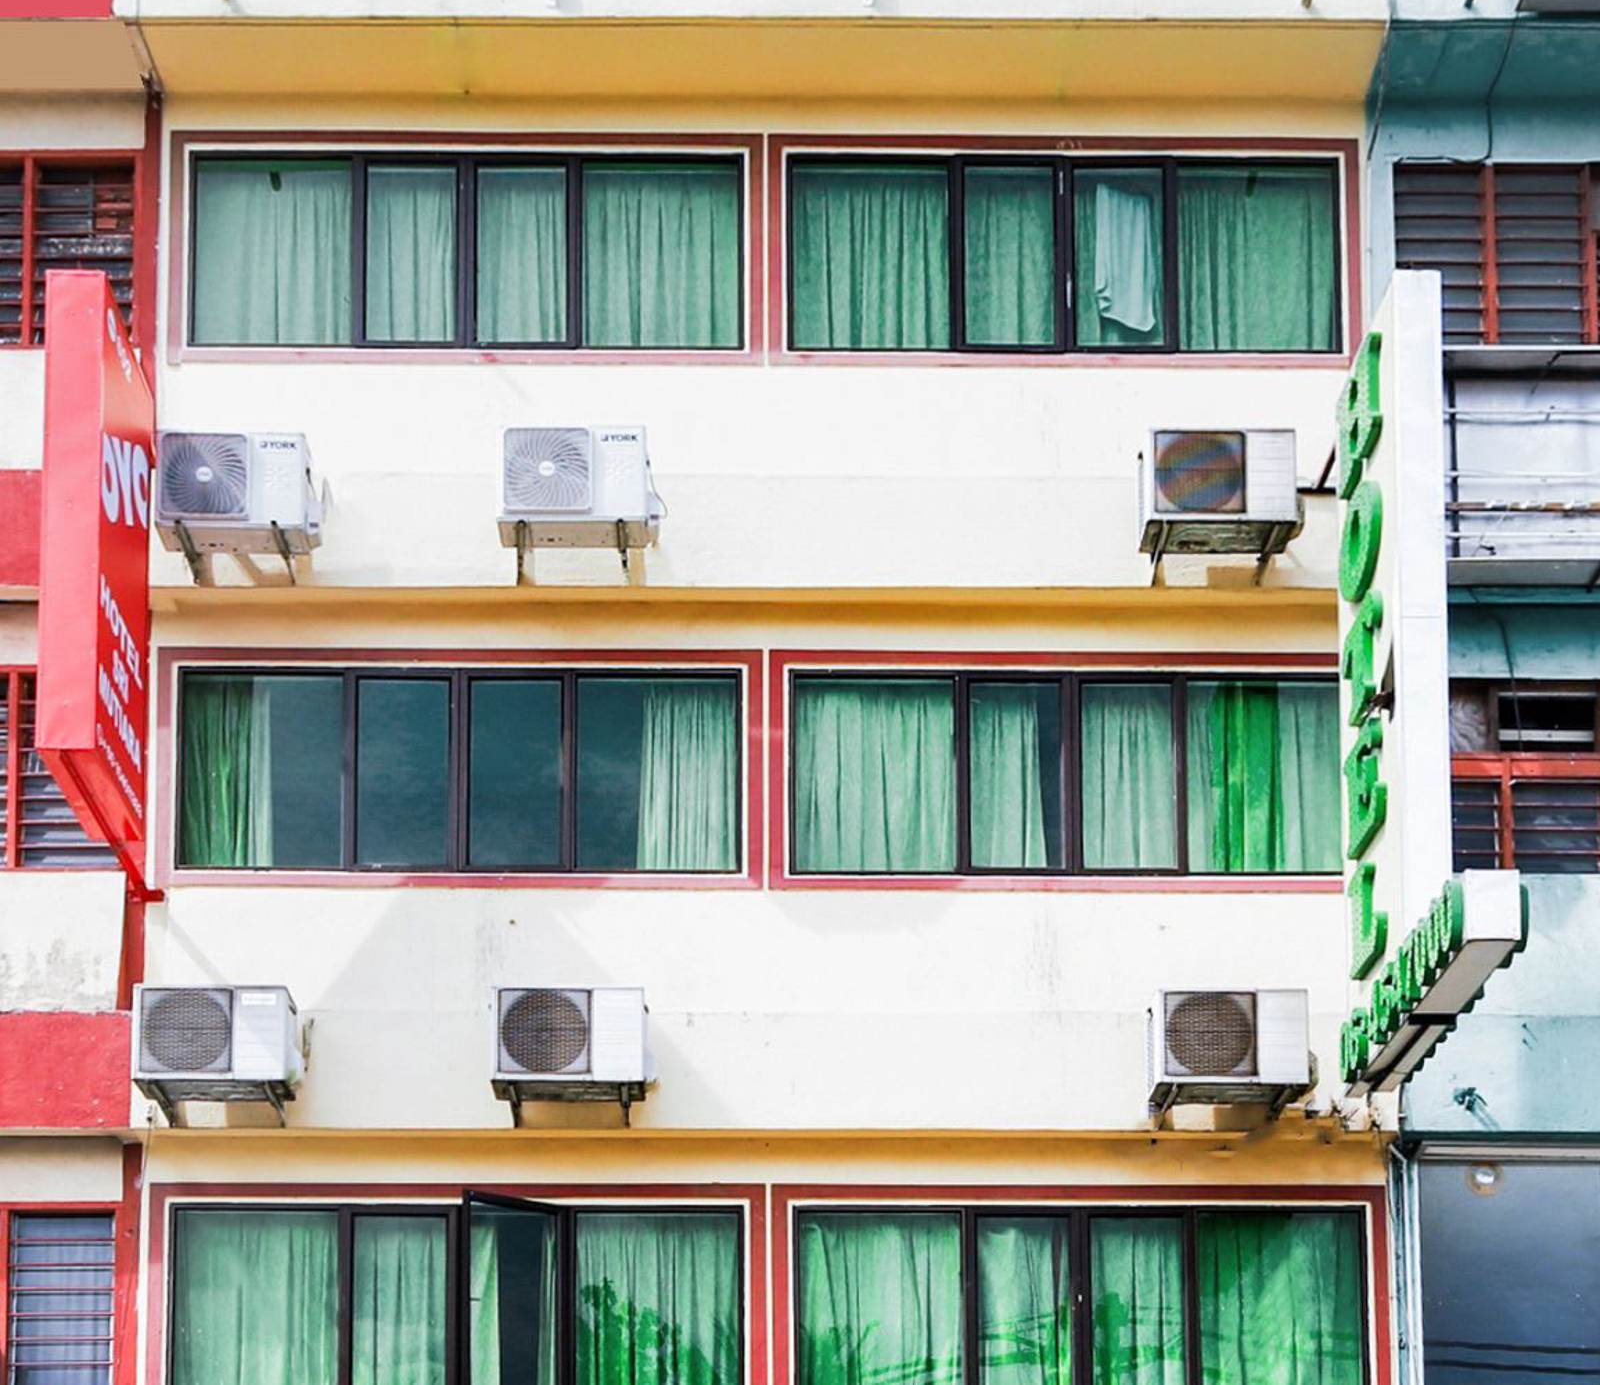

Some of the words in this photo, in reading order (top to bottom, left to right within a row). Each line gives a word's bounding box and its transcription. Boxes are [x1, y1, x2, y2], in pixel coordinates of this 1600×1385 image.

[269, 442, 297, 450] YORK
[610, 434, 638, 443] YORK
[101, 432, 149, 529] OYO
[100, 572, 144, 691] HOTEL
